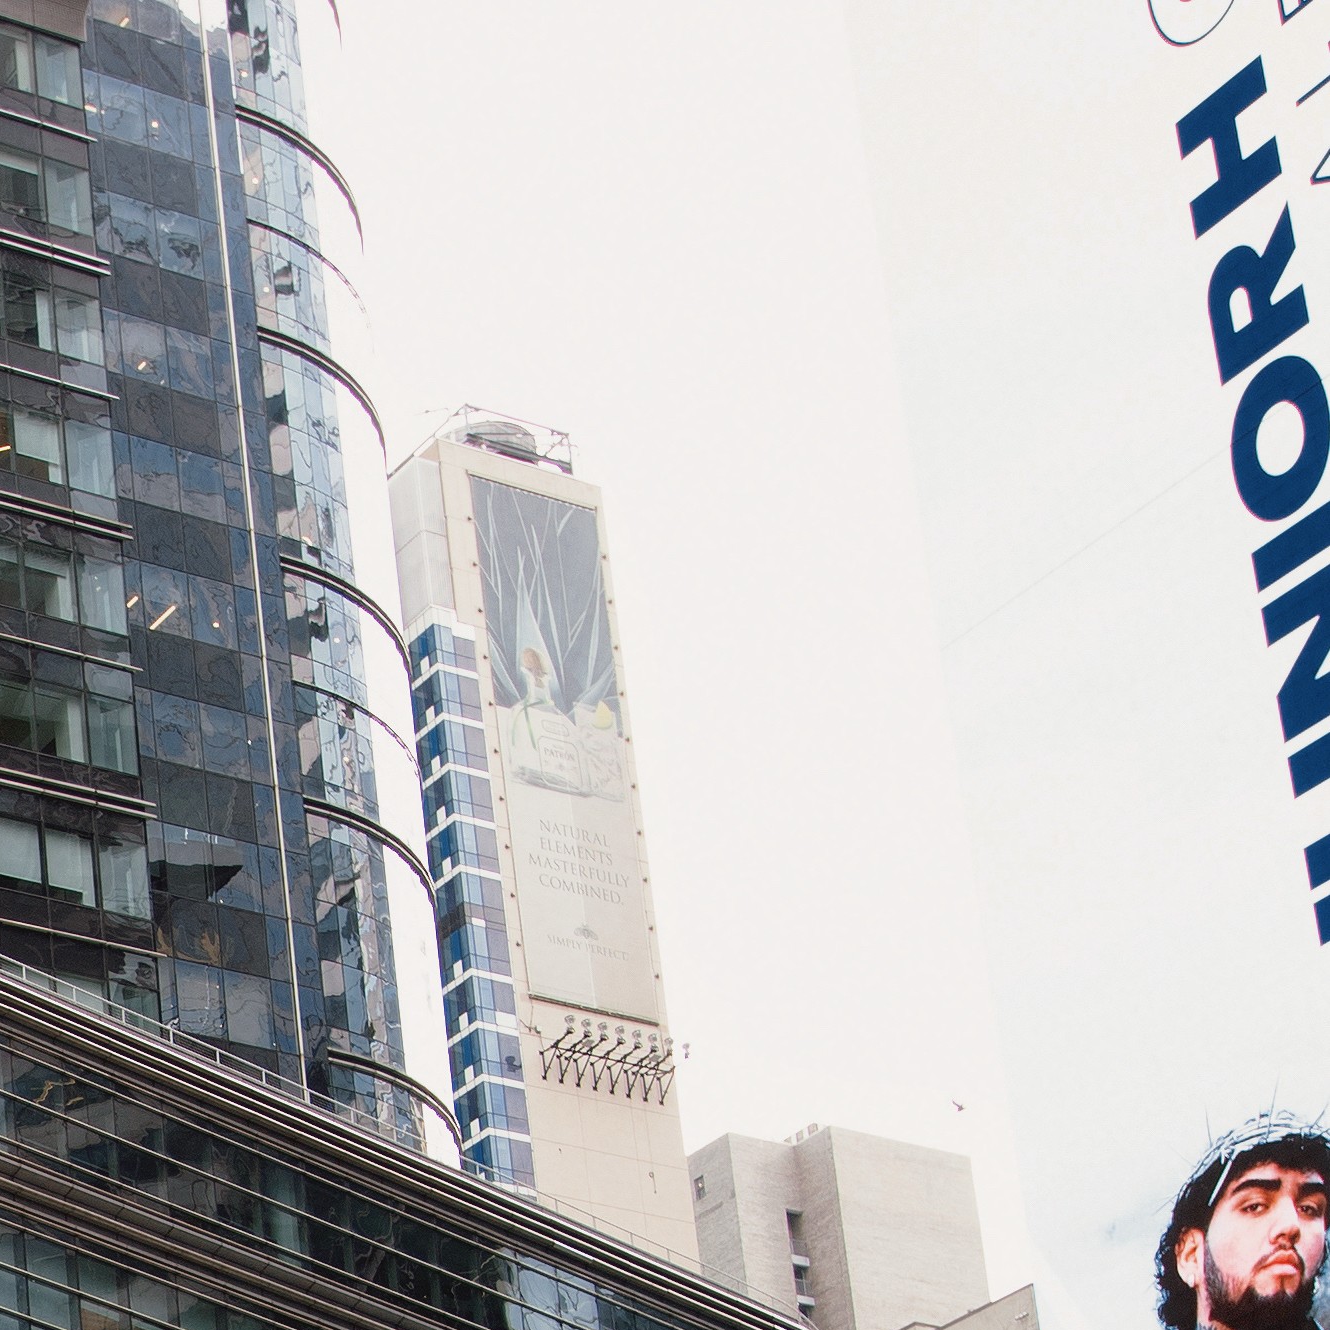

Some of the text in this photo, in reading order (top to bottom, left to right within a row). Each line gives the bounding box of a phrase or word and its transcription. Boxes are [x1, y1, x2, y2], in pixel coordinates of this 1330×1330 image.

[539, 819, 610, 848] NATURAL
[540, 836, 613, 866] ELEMENTS
[528, 852, 630, 888] MASTERFULLY
[538, 873, 625, 906] COMBINED.
[546, 933, 583, 950] SIMPLY
